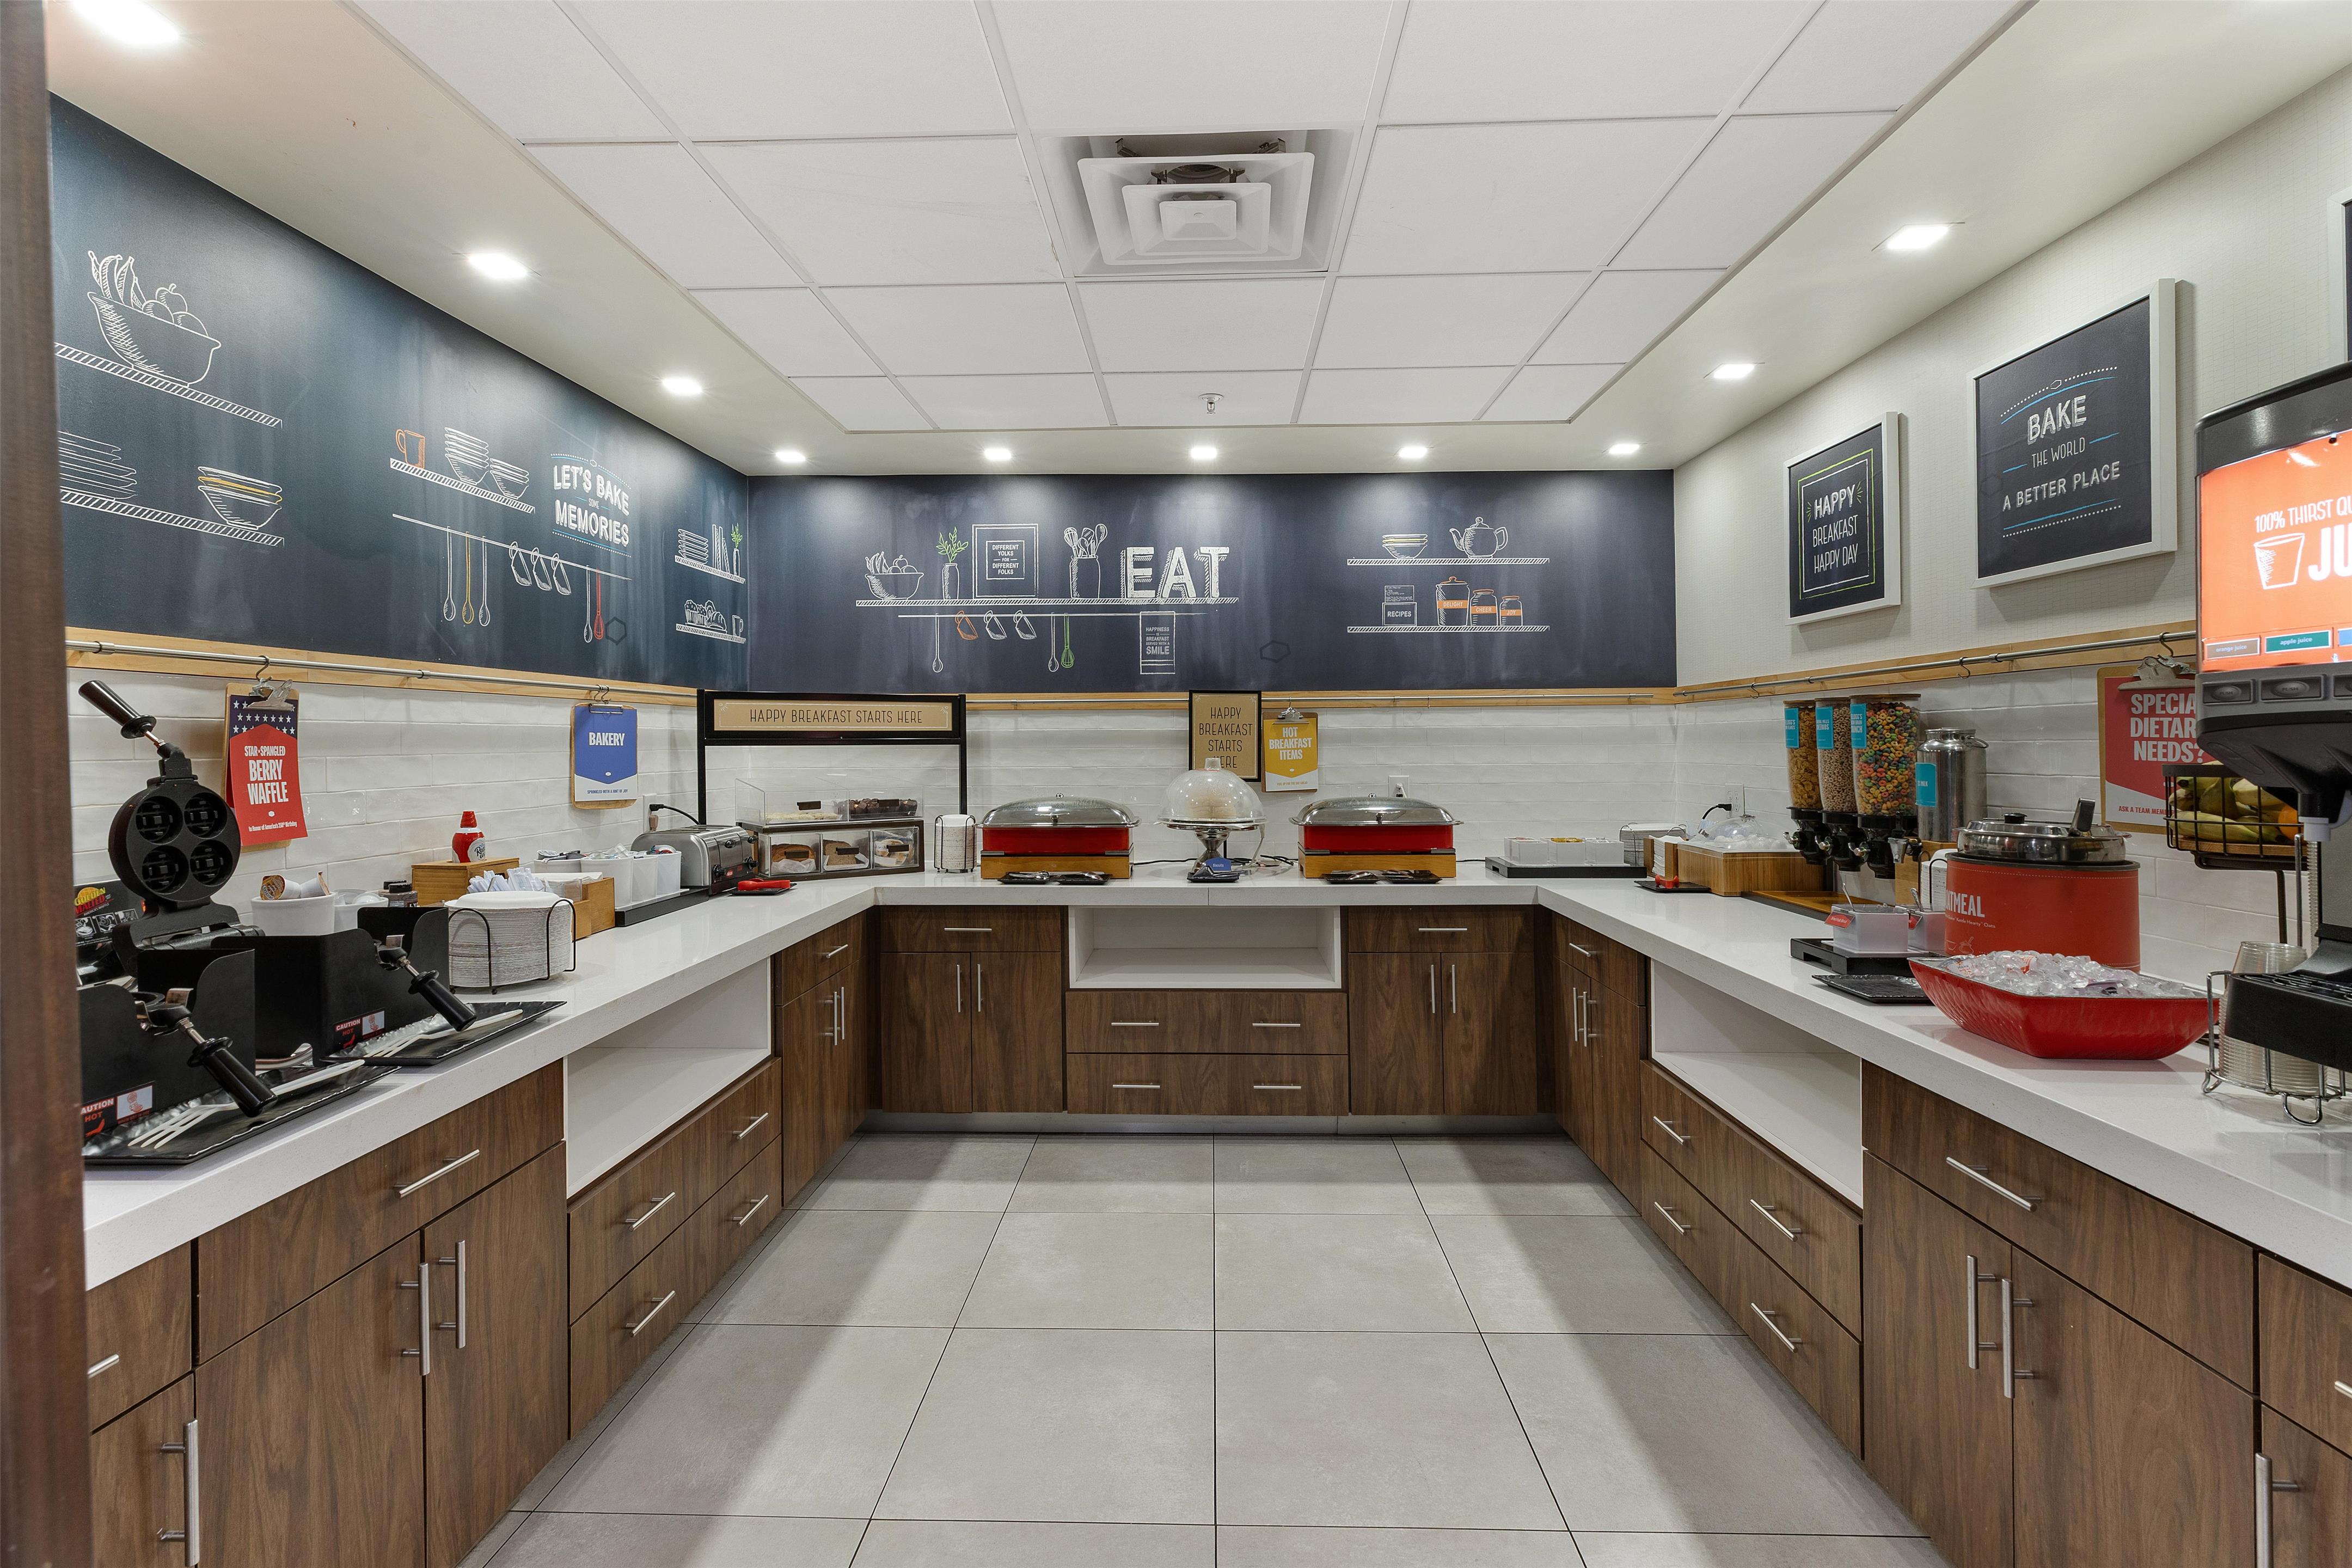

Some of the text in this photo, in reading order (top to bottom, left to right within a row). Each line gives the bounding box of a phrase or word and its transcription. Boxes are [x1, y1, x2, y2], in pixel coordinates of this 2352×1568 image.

[2028, 395, 2087, 445] BAKE
[2031, 437, 2086, 468] THE WORLD
[553, 465, 630, 517] LET'S BAKE
[2002, 461, 2121, 511] A BETTER PLACE
[588, 498, 599, 509] SOME
[1814, 484, 1855, 520] HAPPY
[555, 499, 630, 547] MEMORIES
[2255, 510, 2286, 533] 100%
[2287, 499, 2334, 526] THIRST
[1812, 514, 1859, 548] BREAKFAST
[1814, 543, 1858, 574] HAPPY DAY
[1120, 546, 1230, 598] EAT
[1146, 646, 1170, 655] SMILE
[1210, 707, 1241, 719] HAPPY
[2130, 694, 2196, 715] SPECIA
[750, 709, 923, 724] HAPPY BREAKFAST STARTS HERE
[1199, 724, 1253, 736] BREAKFAST
[1282, 727, 1298, 737] HOT
[2130, 717, 2196, 738] DIETAR
[589, 732, 625, 746] BAKERY
[1208, 739, 1242, 752] STARTS
[1269, 738, 1312, 750] BREAKFAST
[244, 745, 286, 757] STAR SPANGLED
[1280, 750, 1303, 760] ITEMS
[2134, 740, 2205, 763] NEEDS?
[249, 759, 283, 781] BERRY
[247, 781, 289, 805] WAFFLE
[74, 887, 106, 906] GOLDEN
[75, 895, 106, 915] MALTED
[1946, 889, 1985, 917] ATMEAL
[336, 1019, 360, 1031] CAUTION
[342, 1028, 354, 1036] HOT
[80, 1098, 114, 1115] AUTION
[84, 1111, 103, 1123] HOT
